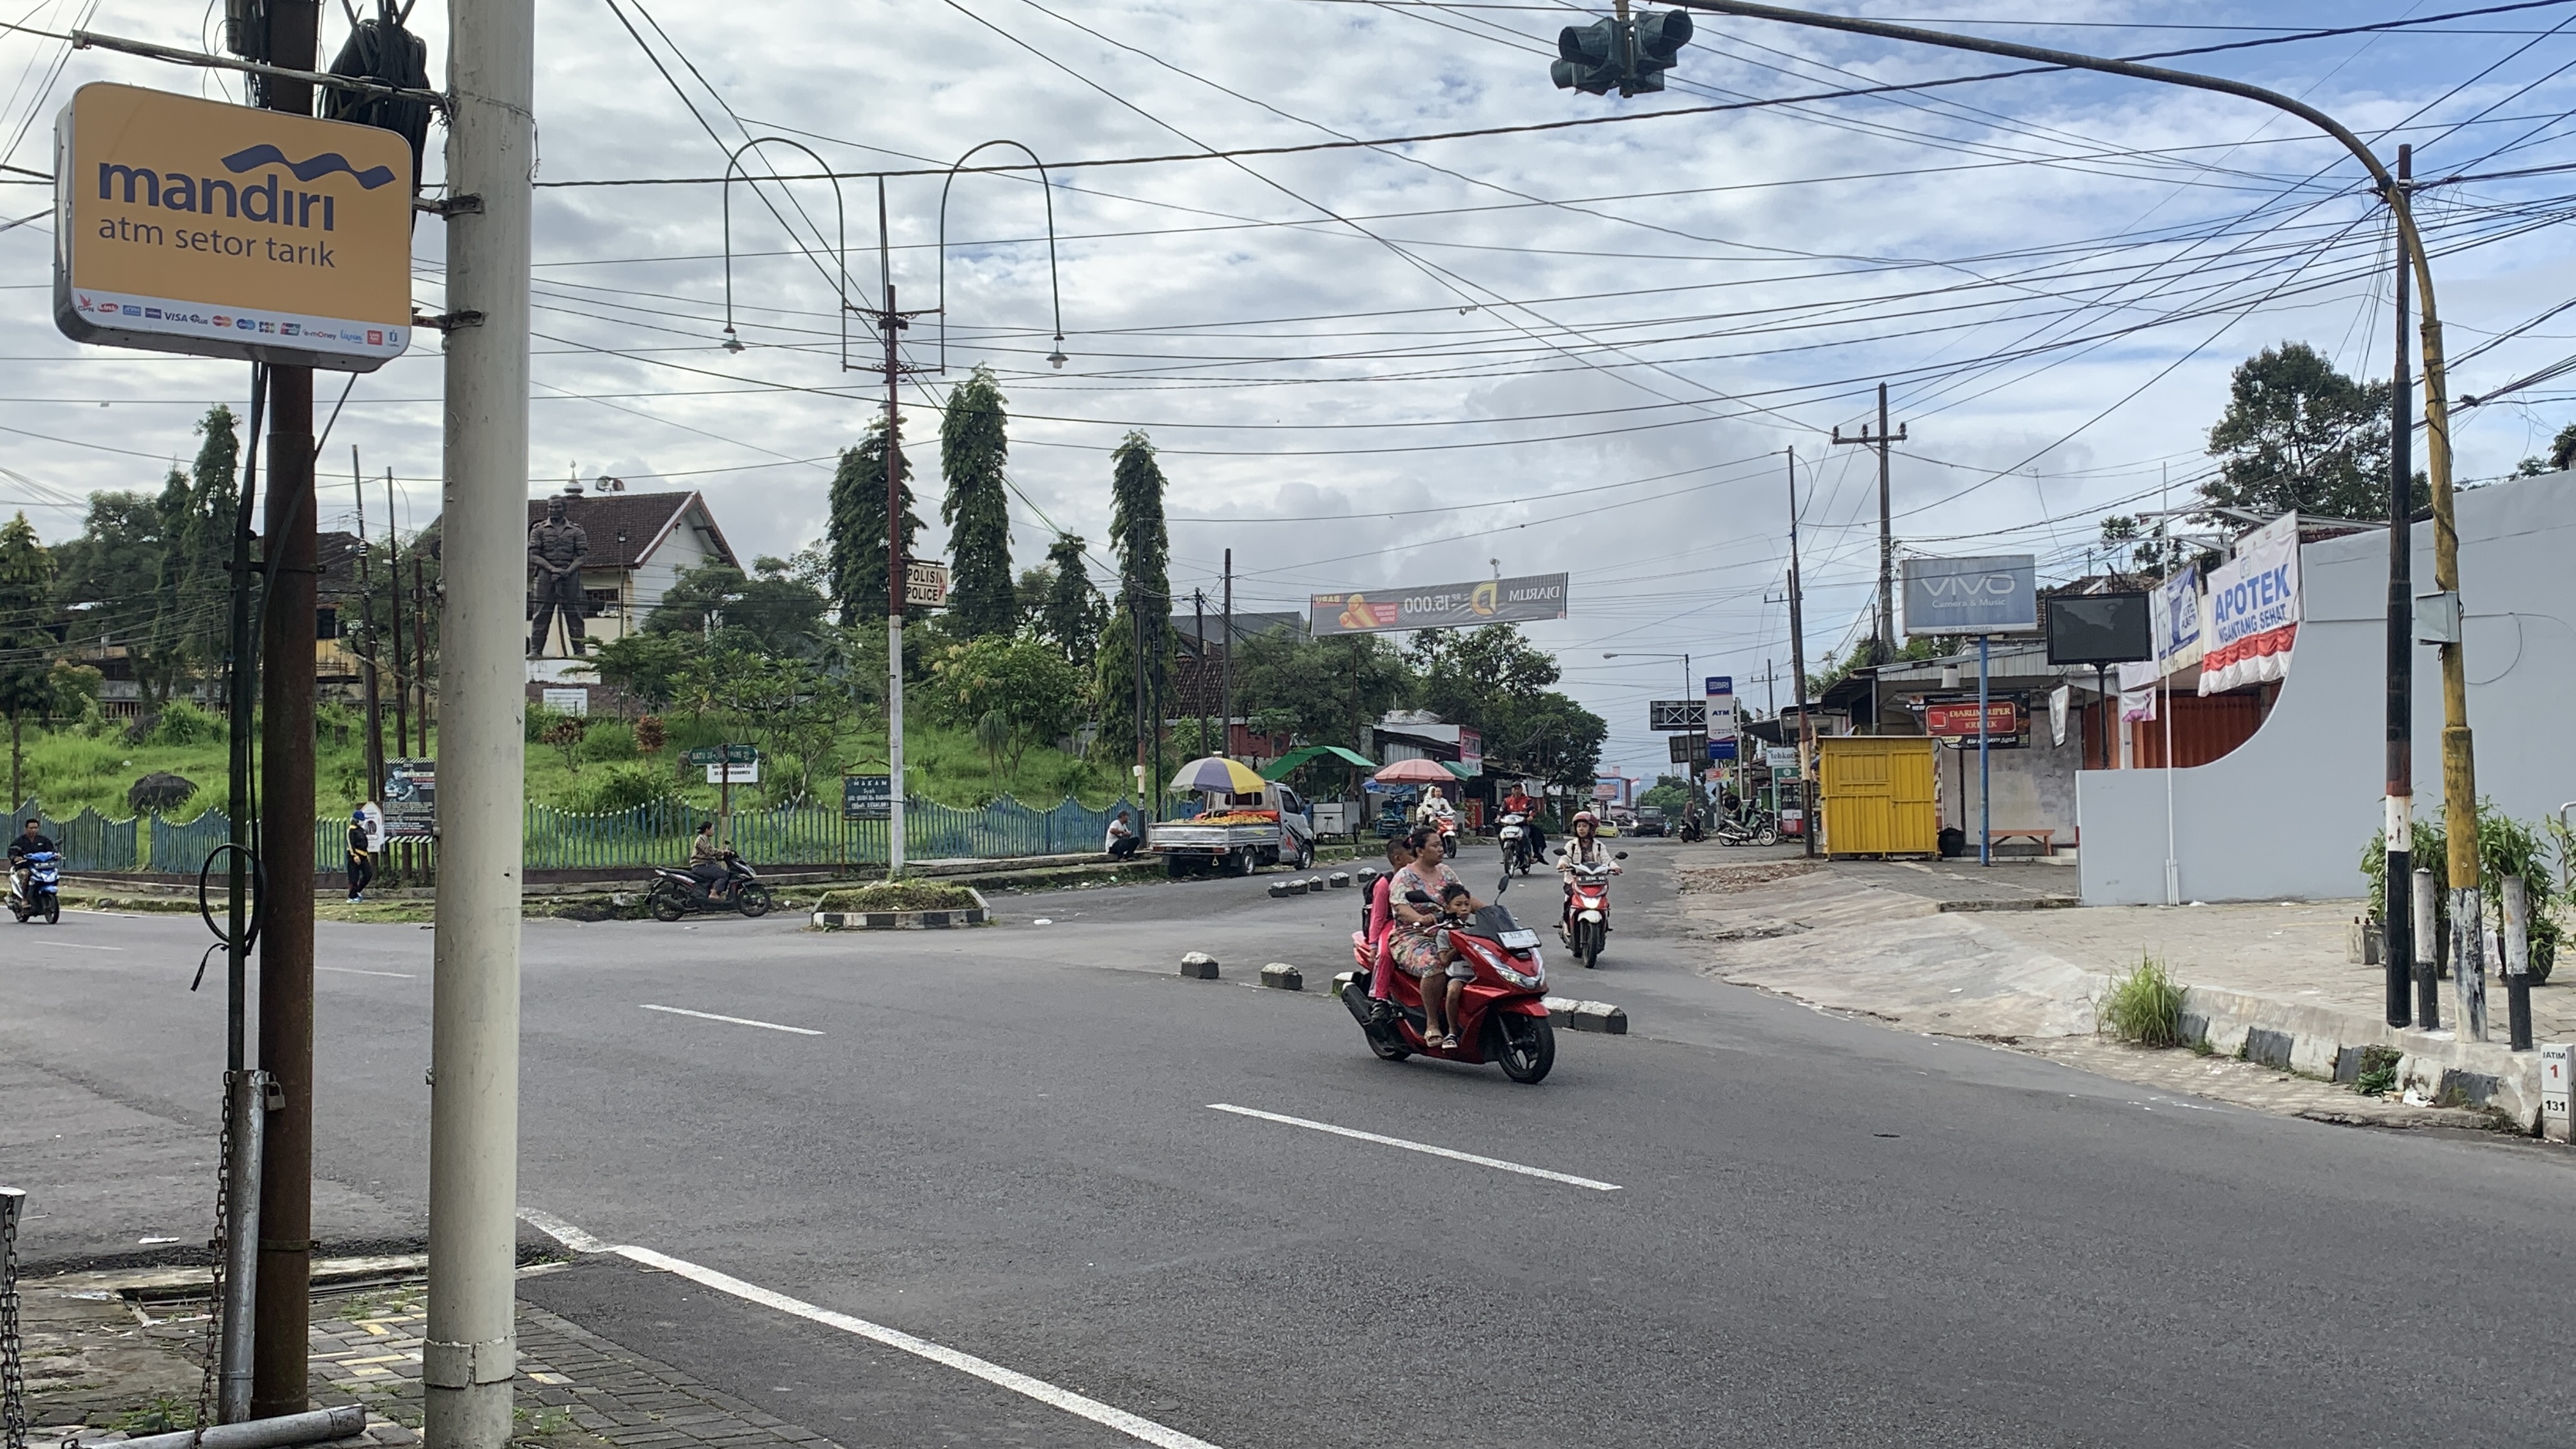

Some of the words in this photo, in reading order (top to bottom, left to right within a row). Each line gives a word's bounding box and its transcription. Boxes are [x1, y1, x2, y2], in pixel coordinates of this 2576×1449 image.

[98, 162, 335, 231] mandiri
[99, 216, 164, 246] atm
[175, 227, 257, 257] setor
[266, 237, 335, 268] tarik
[164, 312, 188, 323] VISA
[907, 568, 939, 584] POLISI
[906, 586, 938, 601] POLICE
[2214, 562, 2291, 626] APOTEK
[1932, 600, 1968, 608] Camera
[1979, 598, 2006, 606] Music
[2218, 615, 2258, 645] NGANTANG
[2259, 603, 2287, 629] SEHAT
[1965, 721, 1998, 729] KREEK
[2542, 1052, 2566, 1060] JATIM
[2550, 1064, 2559, 1078] 1
[2545, 1100, 2566, 1112] 131
